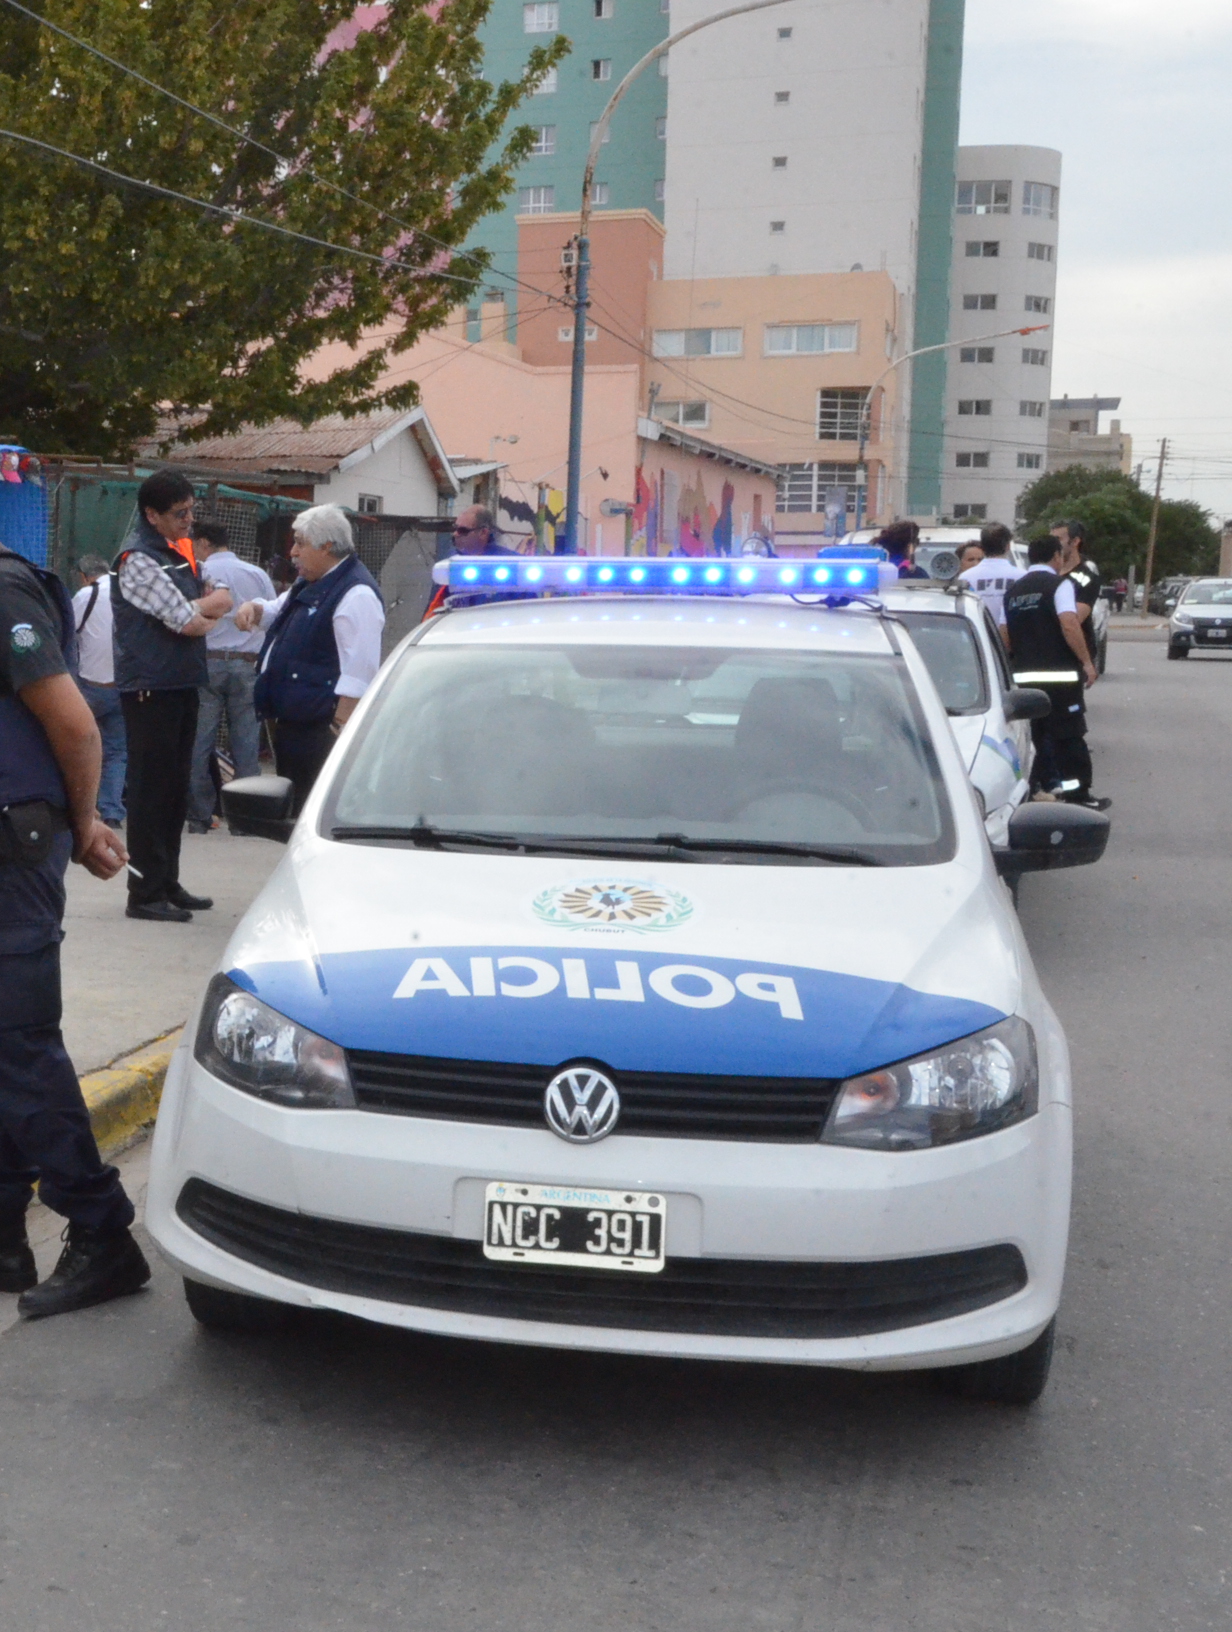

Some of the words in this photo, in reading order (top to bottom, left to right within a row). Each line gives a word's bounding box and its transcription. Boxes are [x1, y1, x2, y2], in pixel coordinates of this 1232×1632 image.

[540, 1188, 611, 1204] ARGENTINA
[491, 1202, 561, 1250] NCC
[585, 1210, 656, 1258] 391
